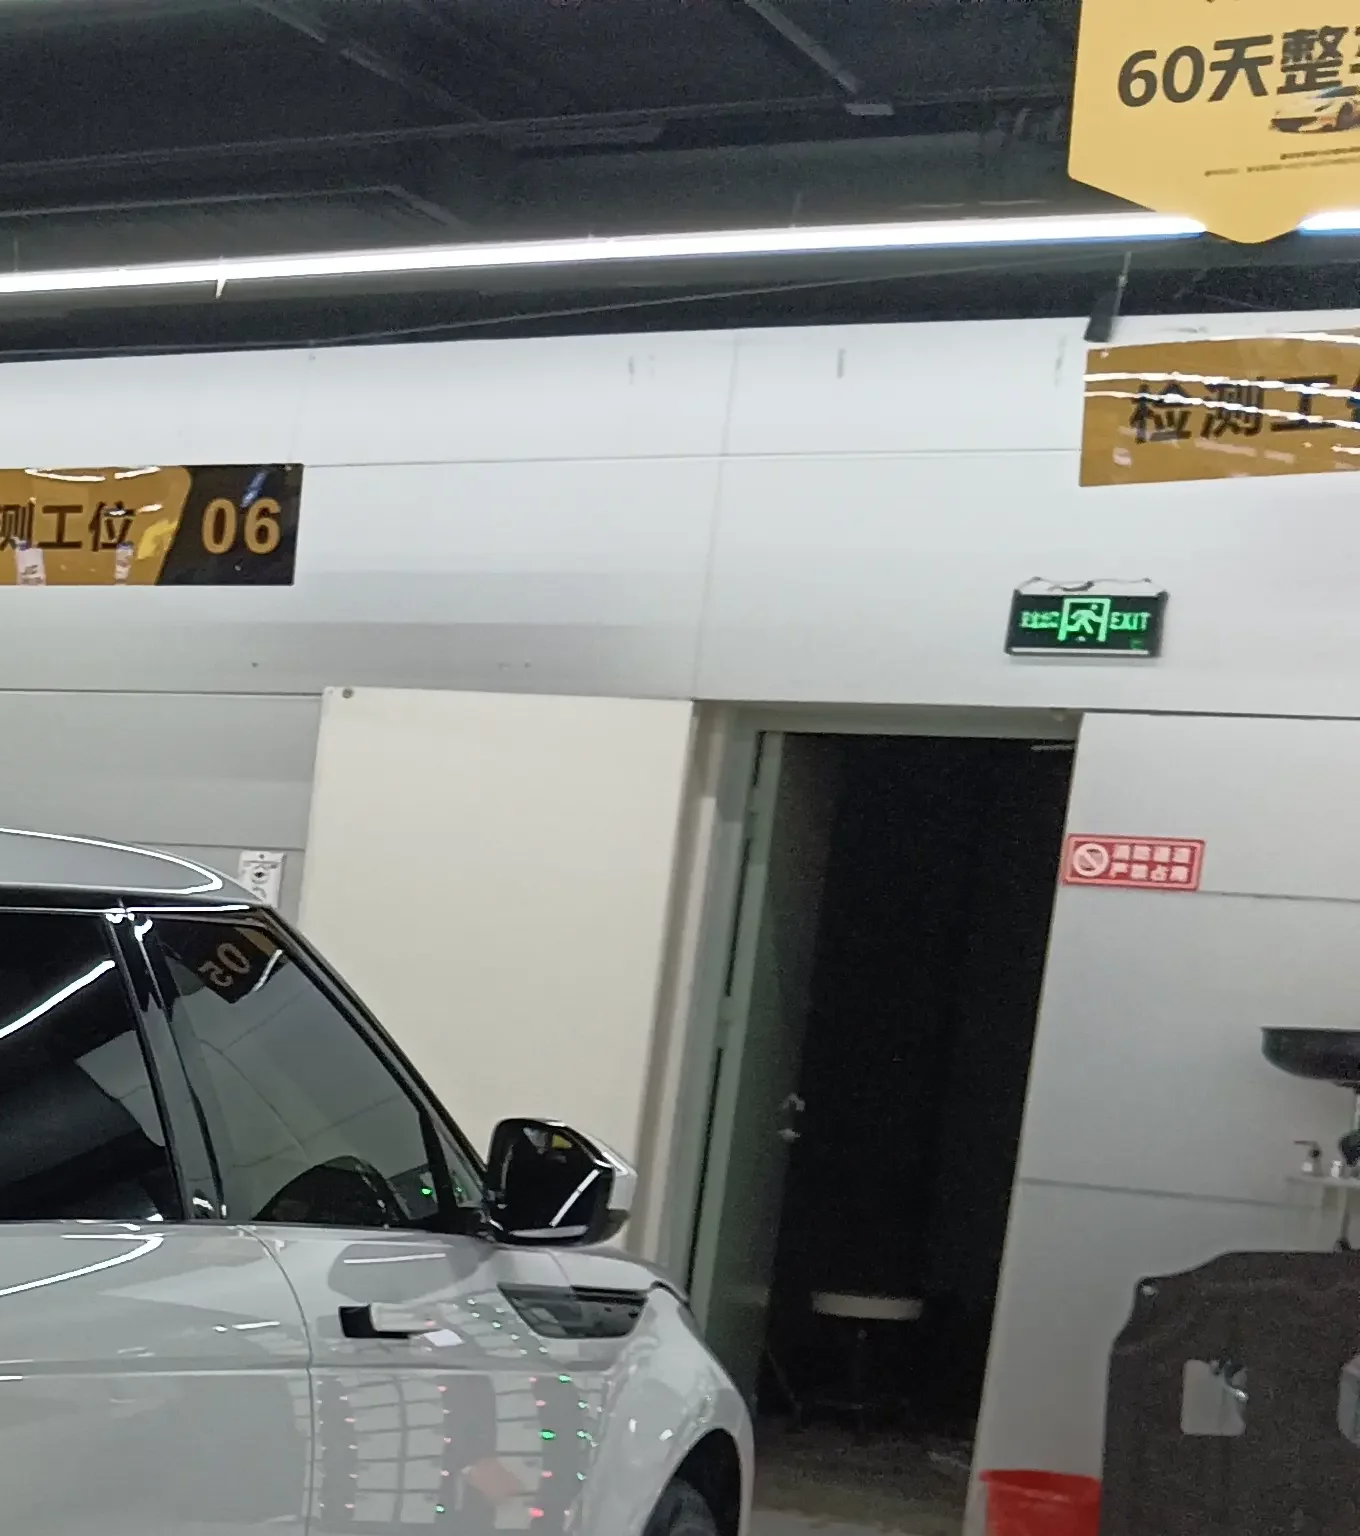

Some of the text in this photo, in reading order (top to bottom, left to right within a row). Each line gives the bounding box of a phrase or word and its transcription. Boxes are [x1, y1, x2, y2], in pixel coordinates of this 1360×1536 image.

[1118, 25, 1360, 107] 60天整
[1130, 375, 1360, 443] 检测工
[202, 498, 280, 554] 06
[1109, 611, 1151, 630] EXIT
